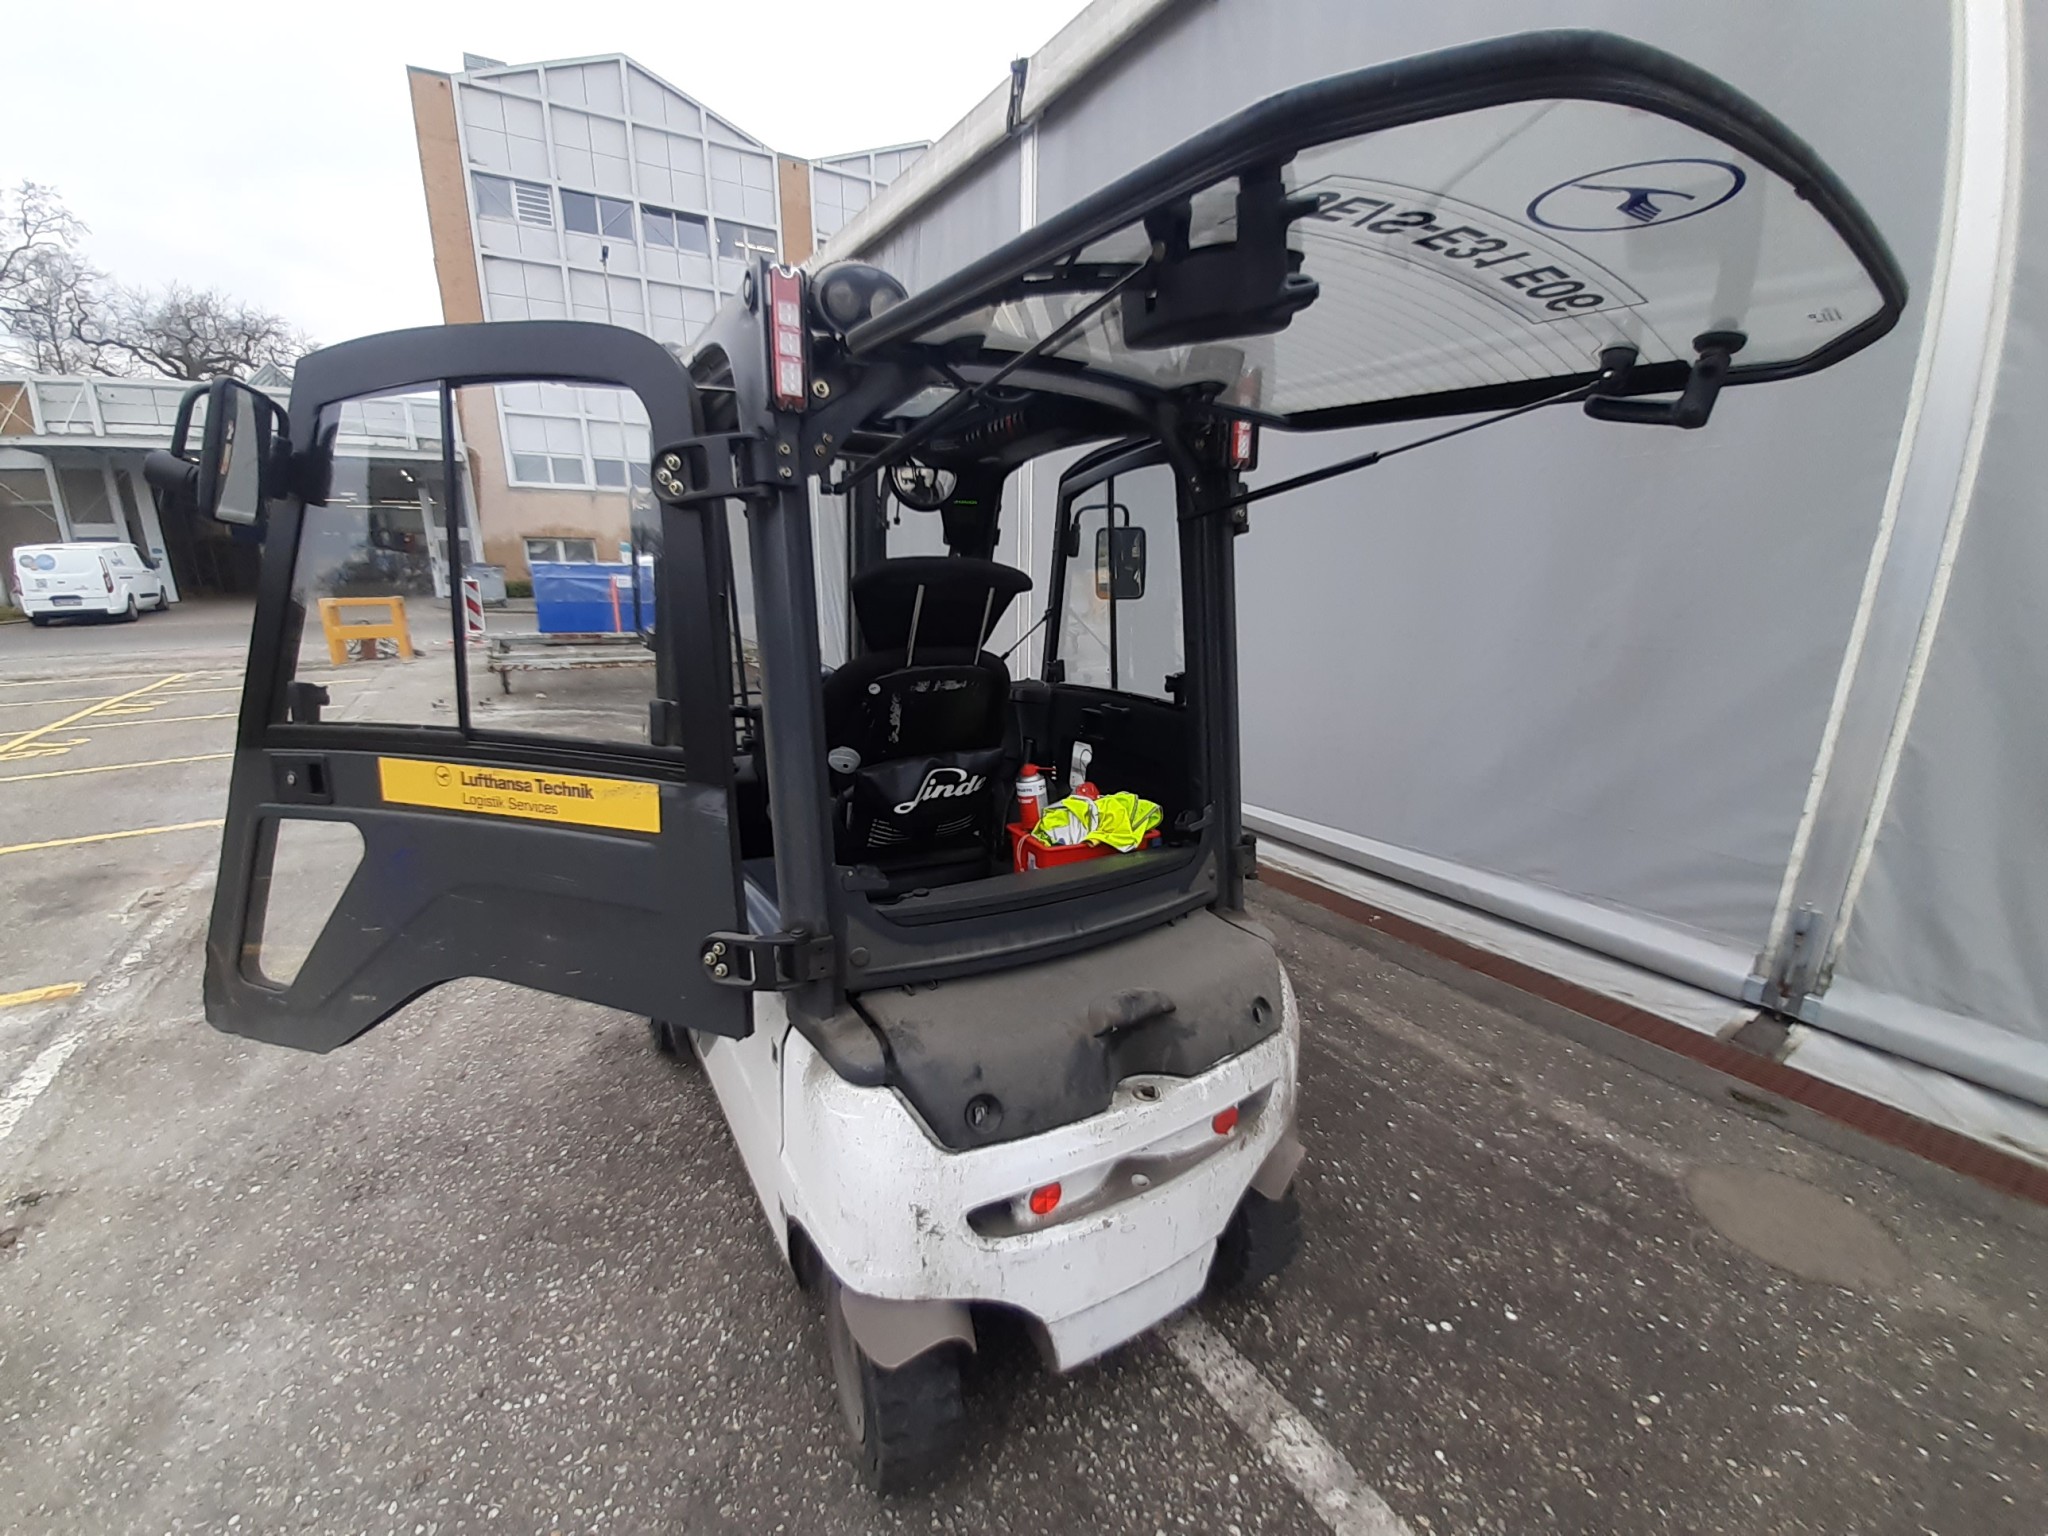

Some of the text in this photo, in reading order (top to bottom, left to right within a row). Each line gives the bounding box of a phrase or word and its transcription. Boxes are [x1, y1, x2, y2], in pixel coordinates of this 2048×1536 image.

[460, 770, 595, 800] Lufthansa Technik
[462, 791, 558, 814] Logistik Services
